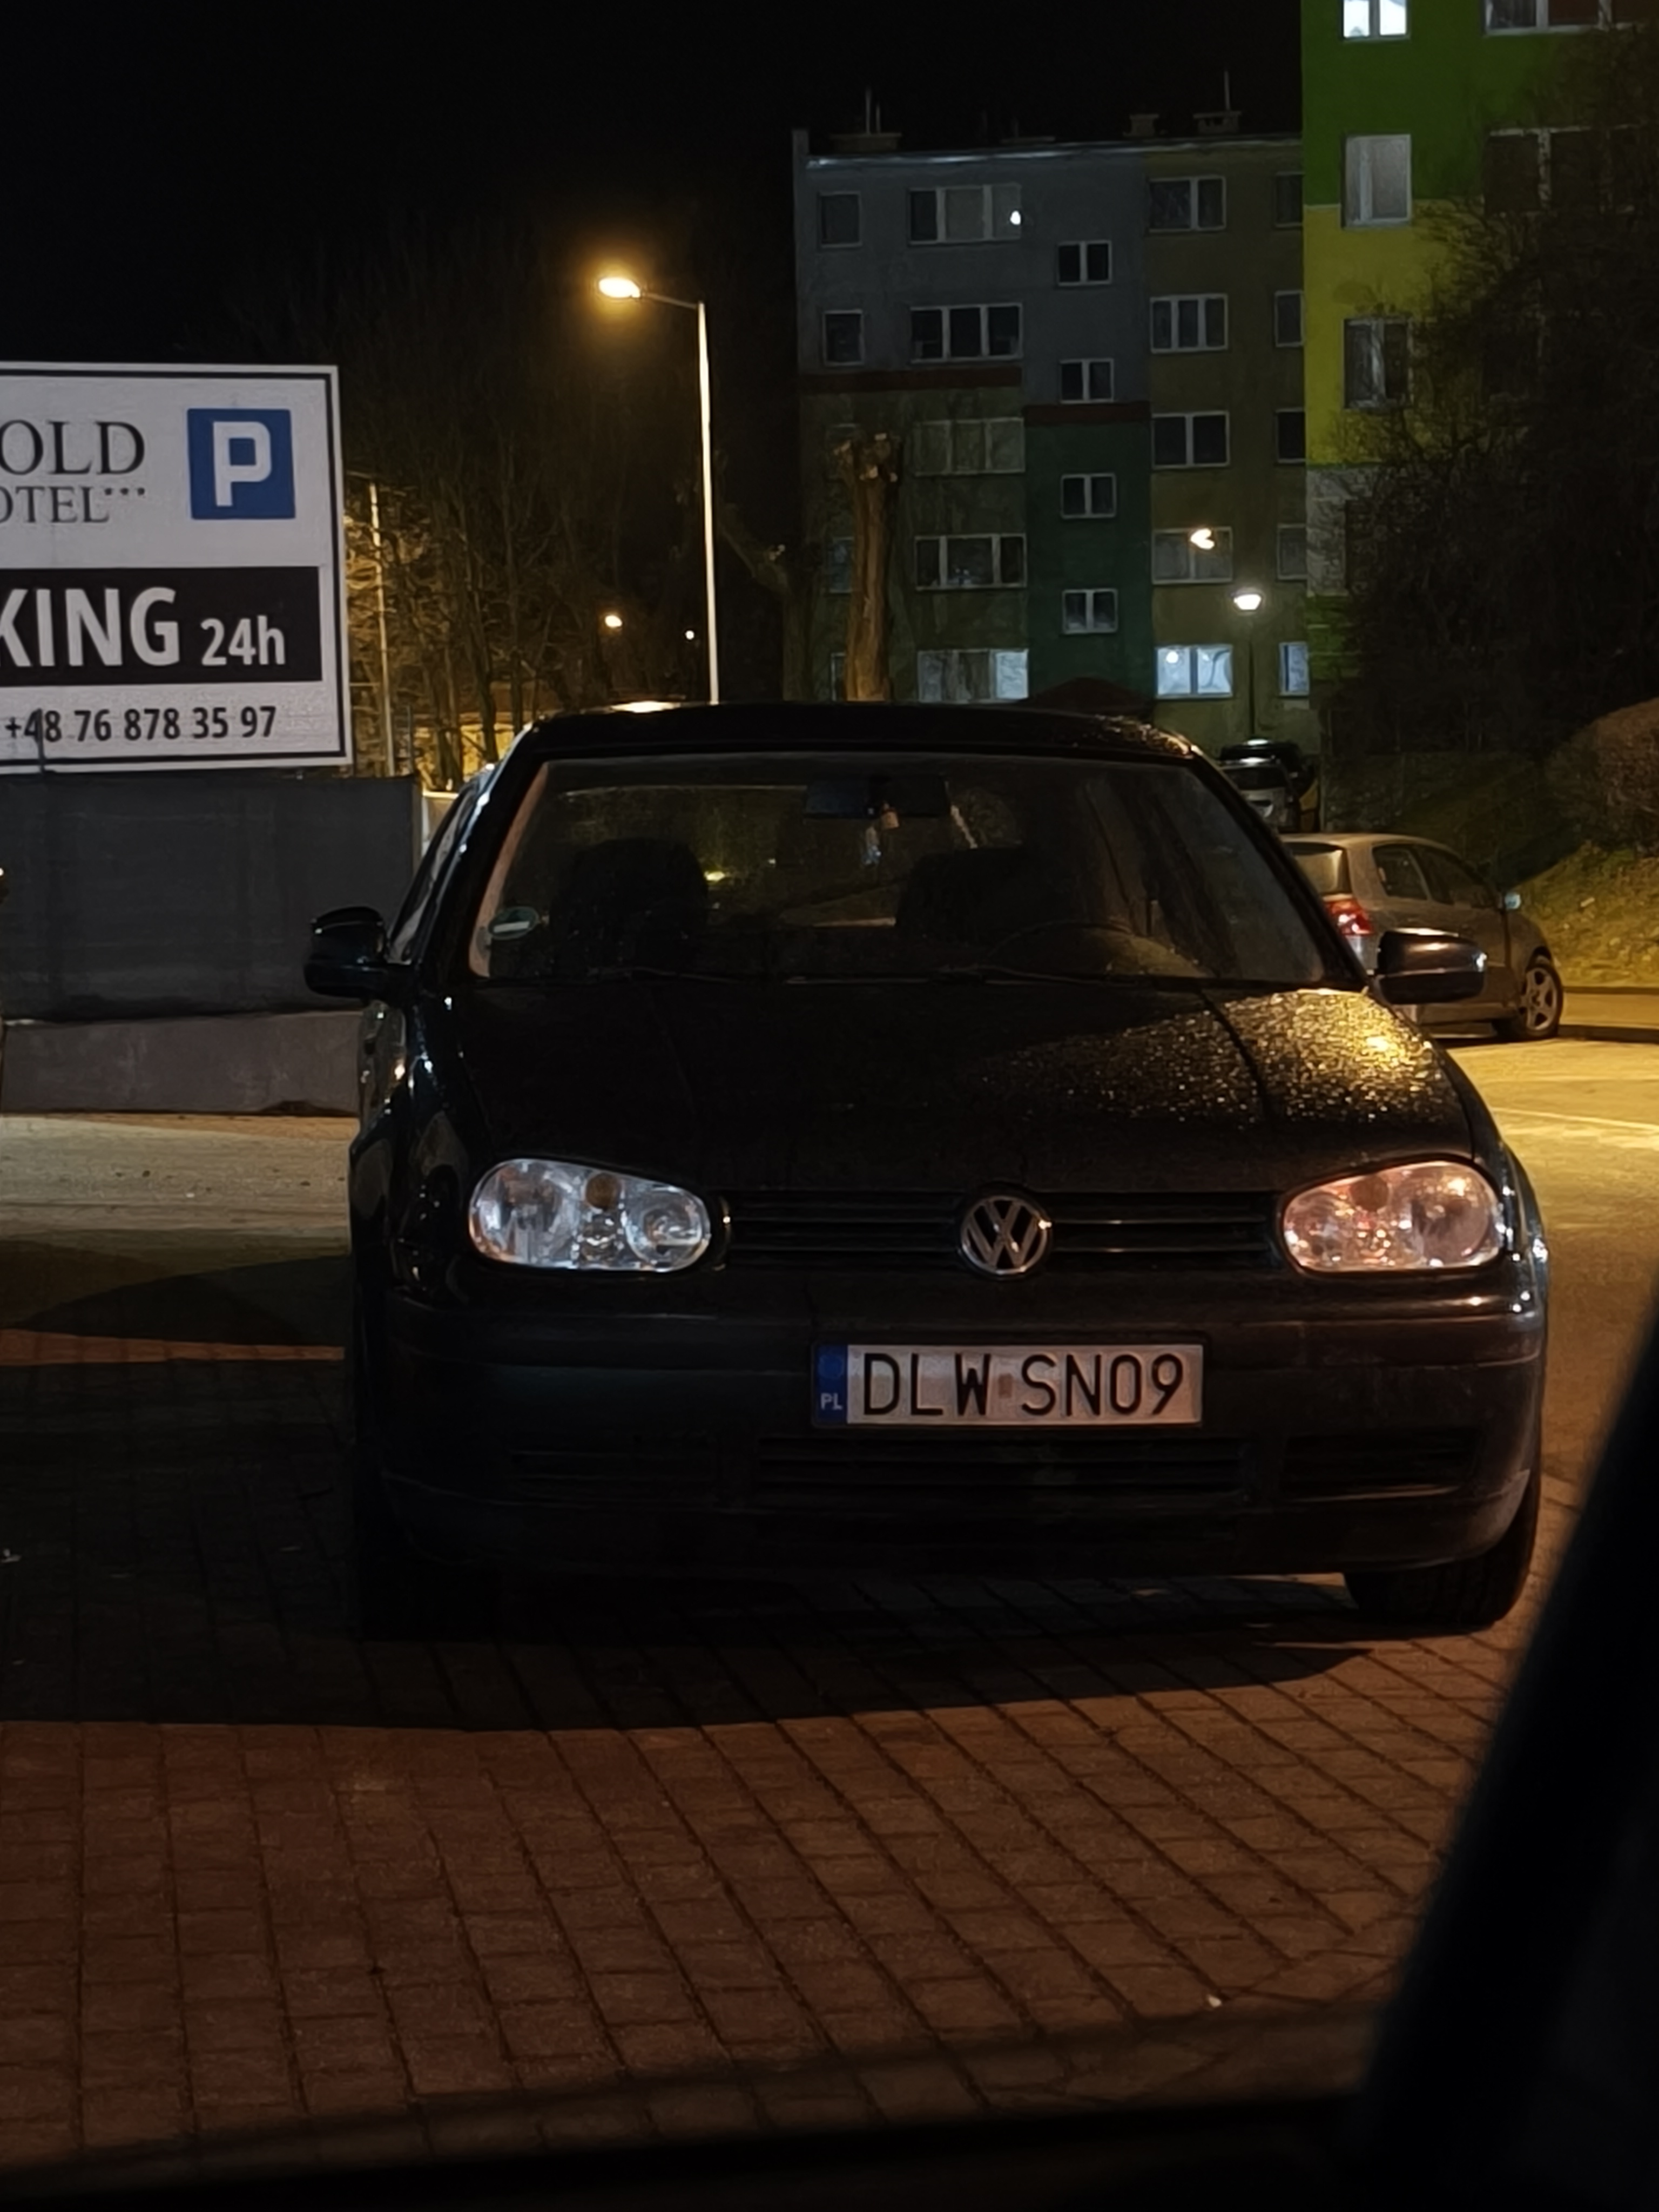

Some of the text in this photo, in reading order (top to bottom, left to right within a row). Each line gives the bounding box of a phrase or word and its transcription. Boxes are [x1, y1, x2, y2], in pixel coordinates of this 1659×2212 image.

[0, 419, 145, 475] OLD
[212, 421, 272, 507] P
[200, 615, 286, 666] 24h
[5, 705, 276, 743] +48 76 878 35 97
[820, 1392, 844, 1411] PL
[863, 1352, 992, 1417] DLW
